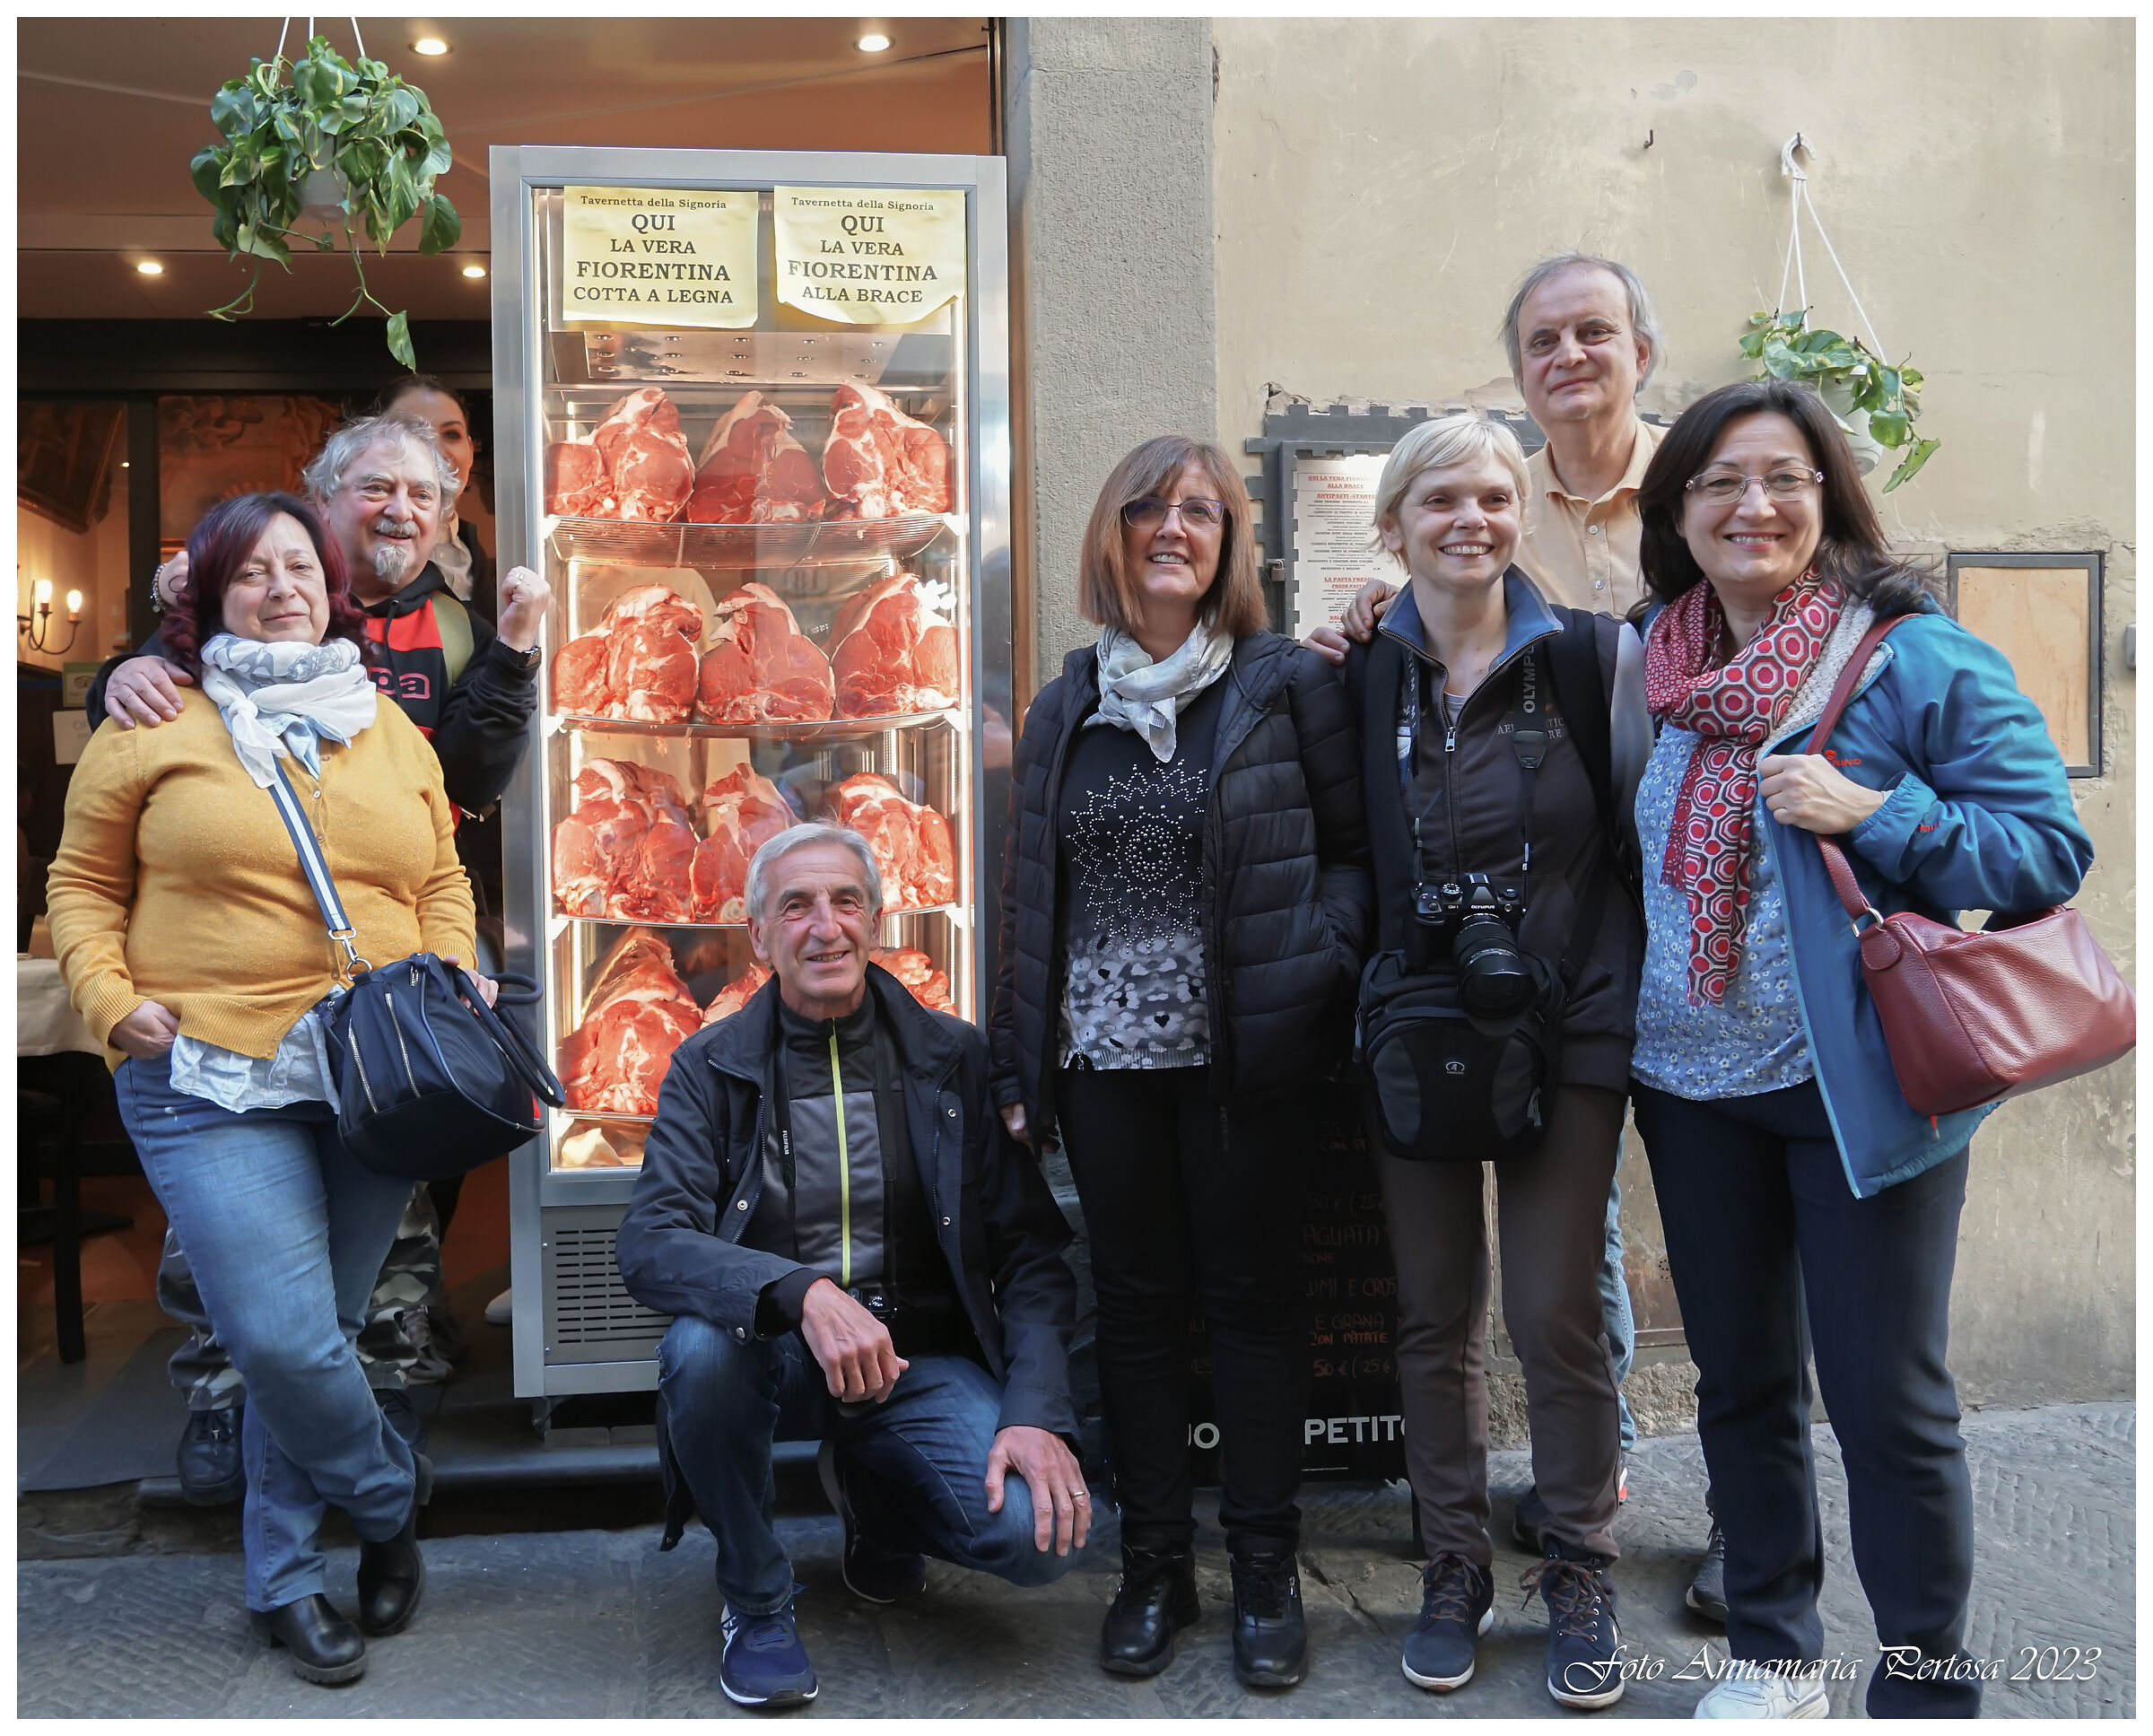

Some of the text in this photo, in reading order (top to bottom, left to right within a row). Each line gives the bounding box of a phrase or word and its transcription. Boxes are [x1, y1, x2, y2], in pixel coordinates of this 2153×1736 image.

[581, 196, 727, 210] Tavernetta della Signoria
[791, 197, 934, 212] Tavernetta della Signoria
[632, 214, 675, 234] QUI
[841, 215, 884, 236] QUI
[610, 239, 696, 254] LA VERA
[821, 240, 904, 256] LA VERA
[576, 261, 731, 281] FIORENTINA
[788, 260, 937, 281] FIORENTINA
[573, 287, 734, 303] COTTA A LEGNA
[802, 286, 923, 303] ALLA BRACE
[1301, 1224, 1379, 1247] AGLIATA
[1314, 1313, 1327, 1330] E
[1331, 1312, 1384, 1331] GRANA
[1342, 1330, 1389, 1345] PATATE
